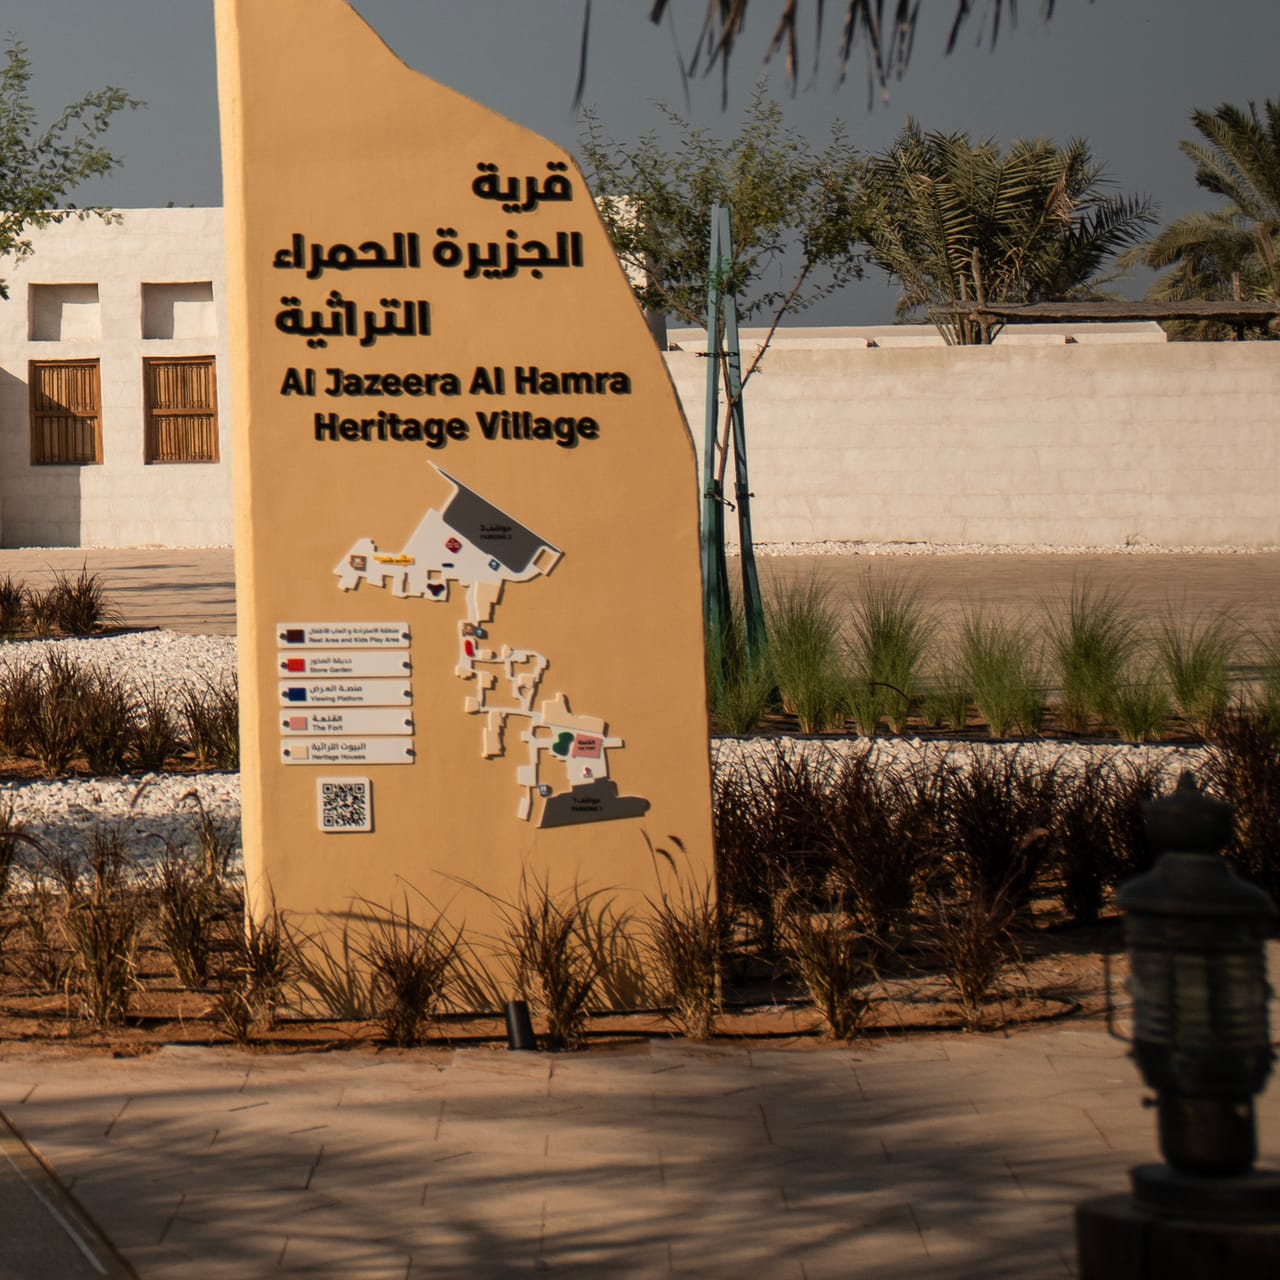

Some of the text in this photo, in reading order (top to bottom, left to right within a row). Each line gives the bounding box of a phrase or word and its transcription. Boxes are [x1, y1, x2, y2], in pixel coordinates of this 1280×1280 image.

[472, 161, 573, 214] قرية
[273, 227, 583, 280] الجزيرة الحمراء
[275, 290, 431, 349] التراثية
[280, 366, 632, 397] Al Jazeera Al Hamra
[314, 409, 600, 450] Heritage Village
[369, 636, 383, 644] Play
[340, 742, 367, 752] البيوت
